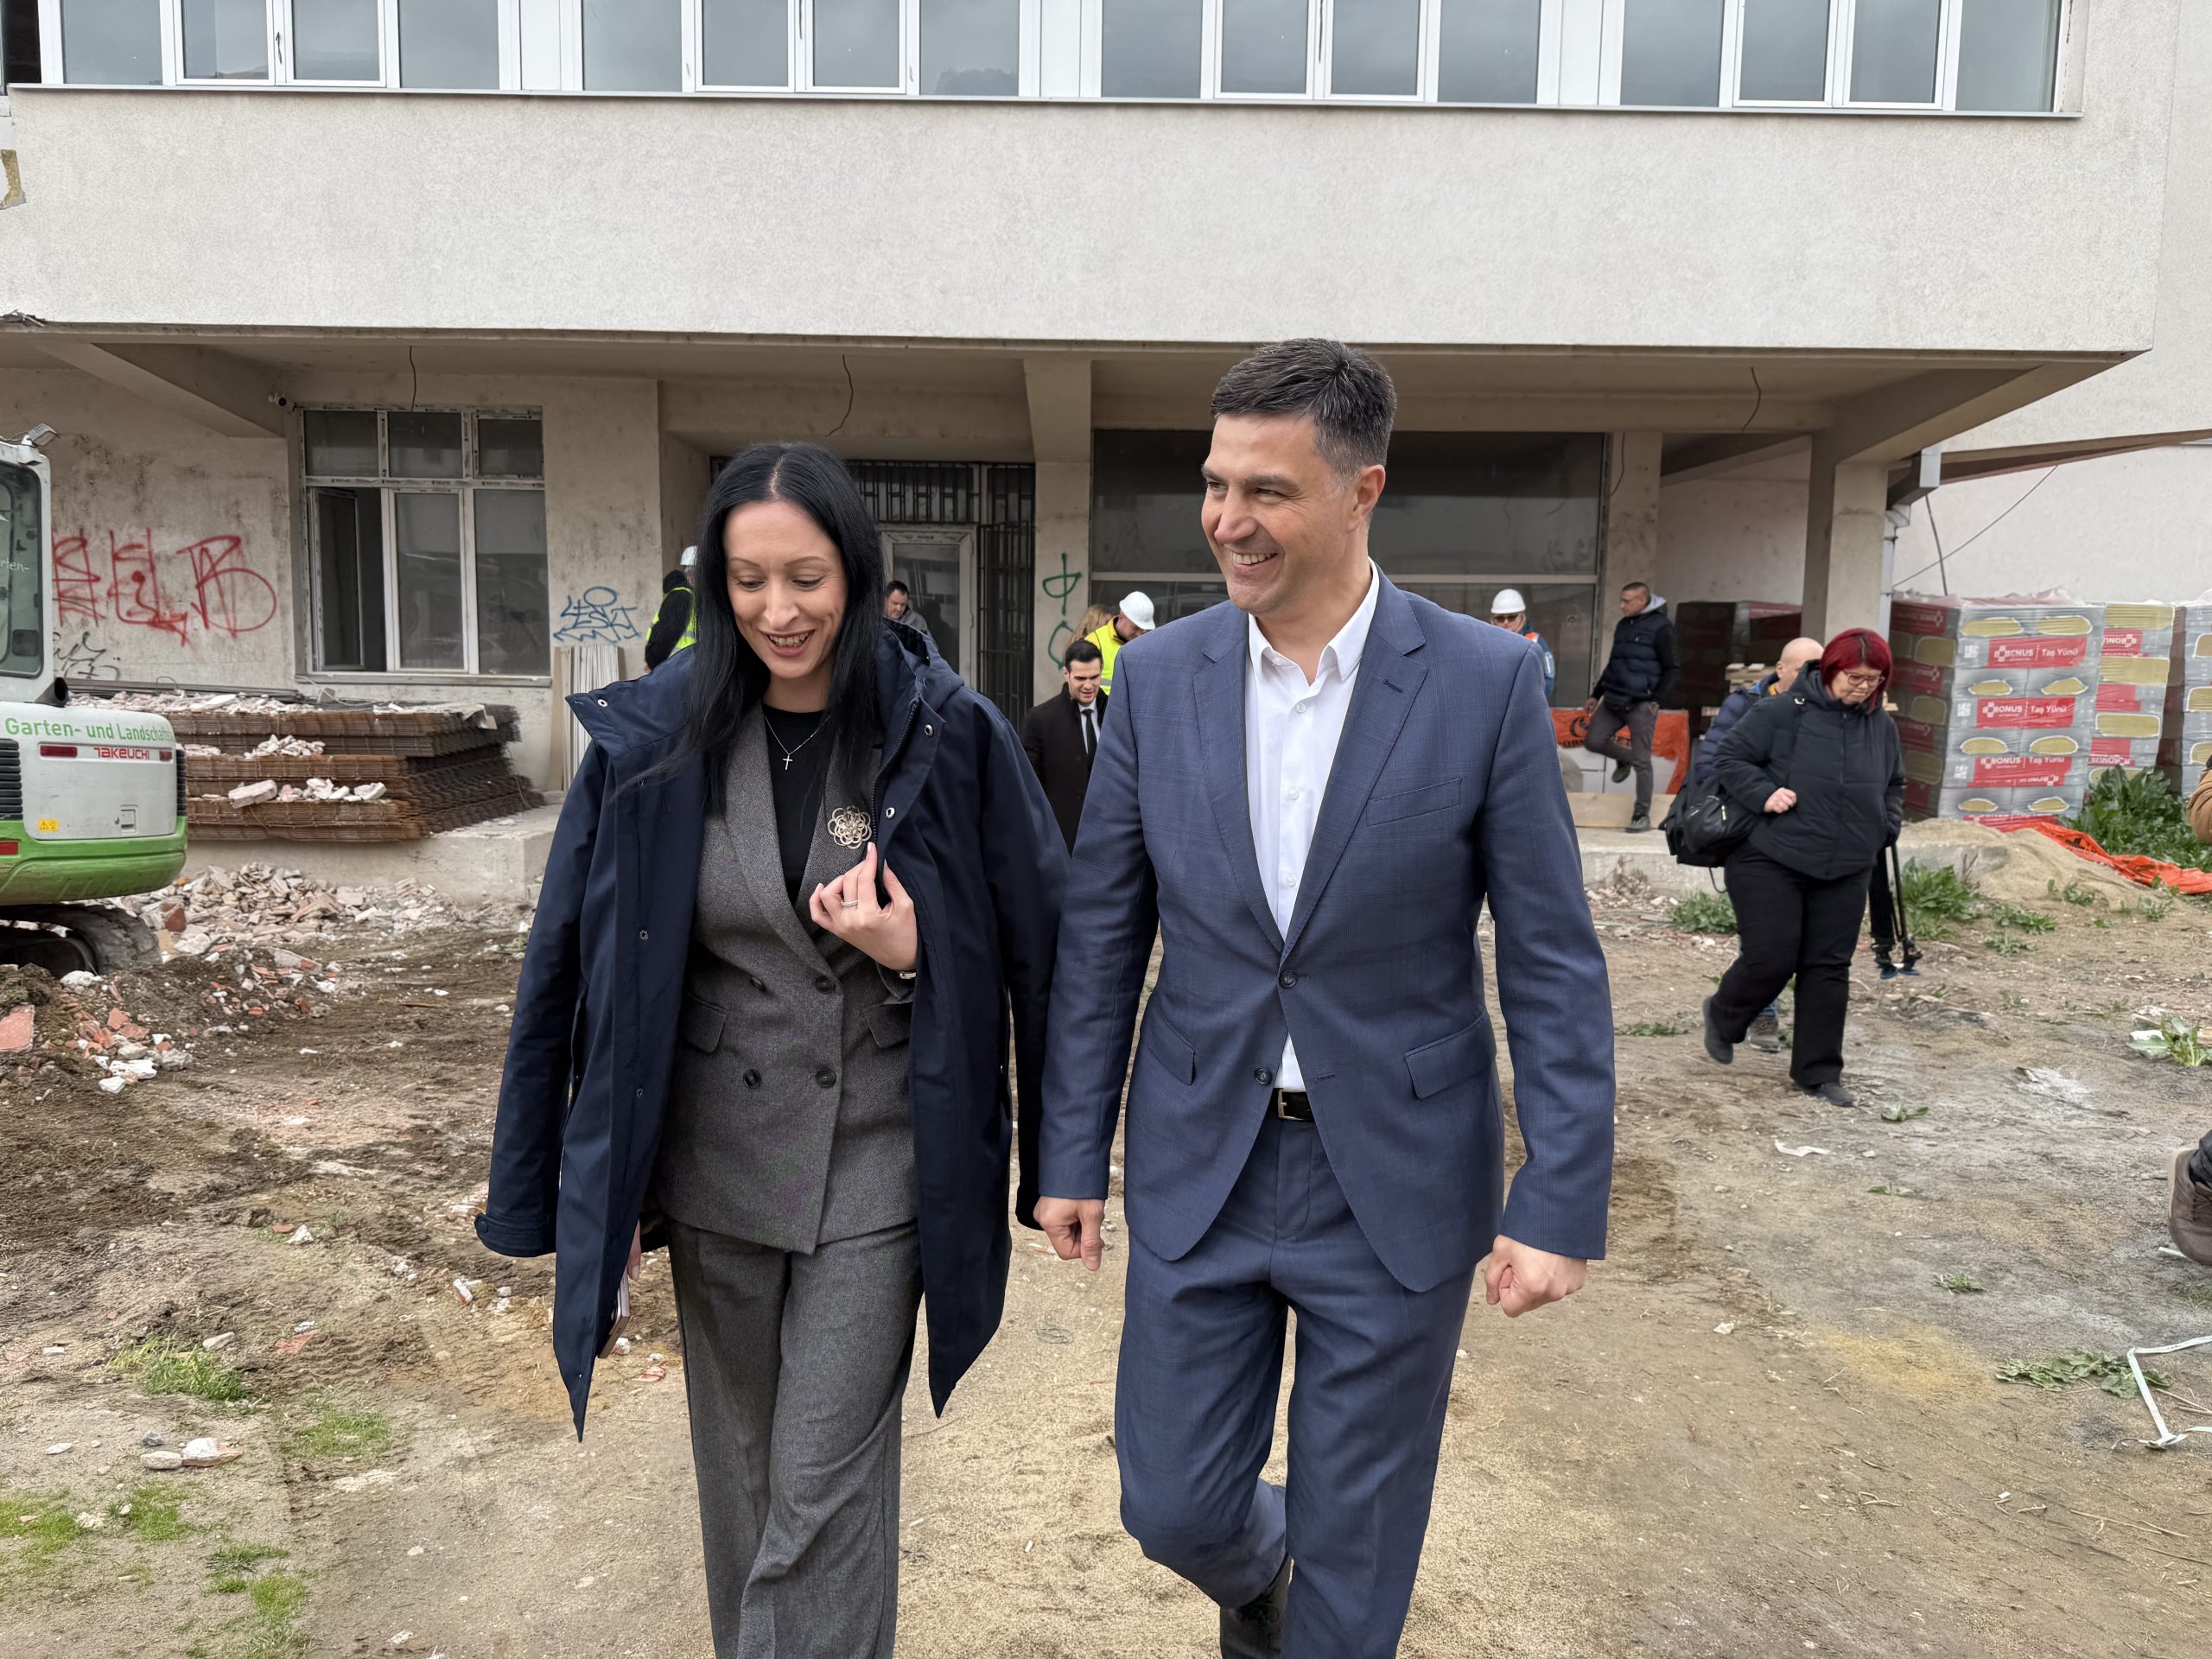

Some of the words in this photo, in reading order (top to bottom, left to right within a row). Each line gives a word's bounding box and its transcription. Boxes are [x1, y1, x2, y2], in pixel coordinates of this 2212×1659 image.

[4, 717, 81, 737] Garten-
[86, 722, 114, 740] und
[93, 747, 150, 760] TAKEUCHI
